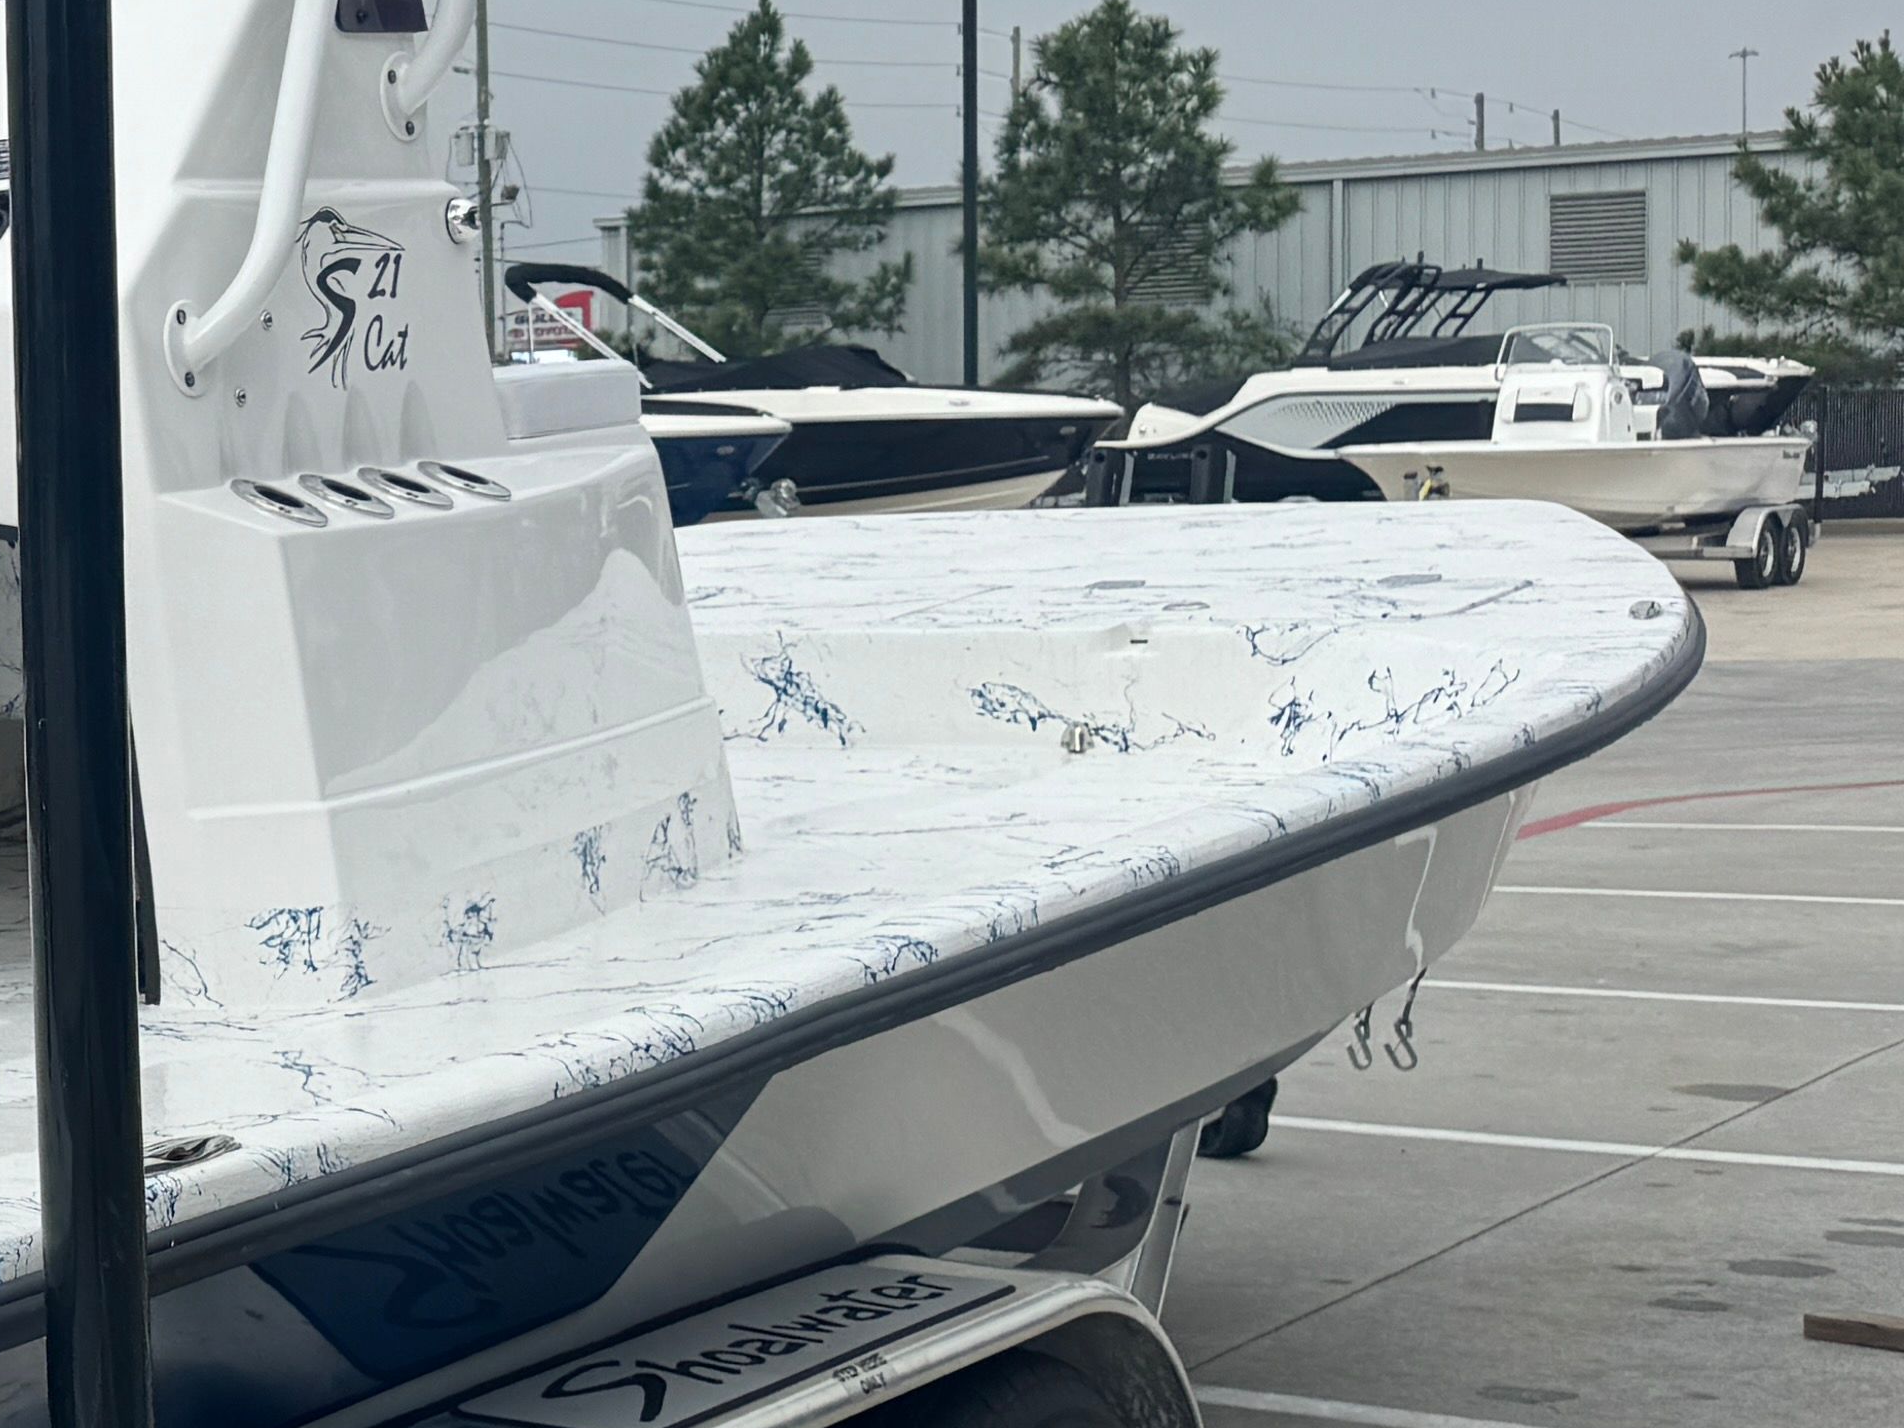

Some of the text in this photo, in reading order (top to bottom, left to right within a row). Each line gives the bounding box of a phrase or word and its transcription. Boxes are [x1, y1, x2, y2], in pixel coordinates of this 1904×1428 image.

[367, 252, 402, 300] 21
[363, 314, 409, 372] Cat
[540, 1274, 954, 1423] Shoalwater
